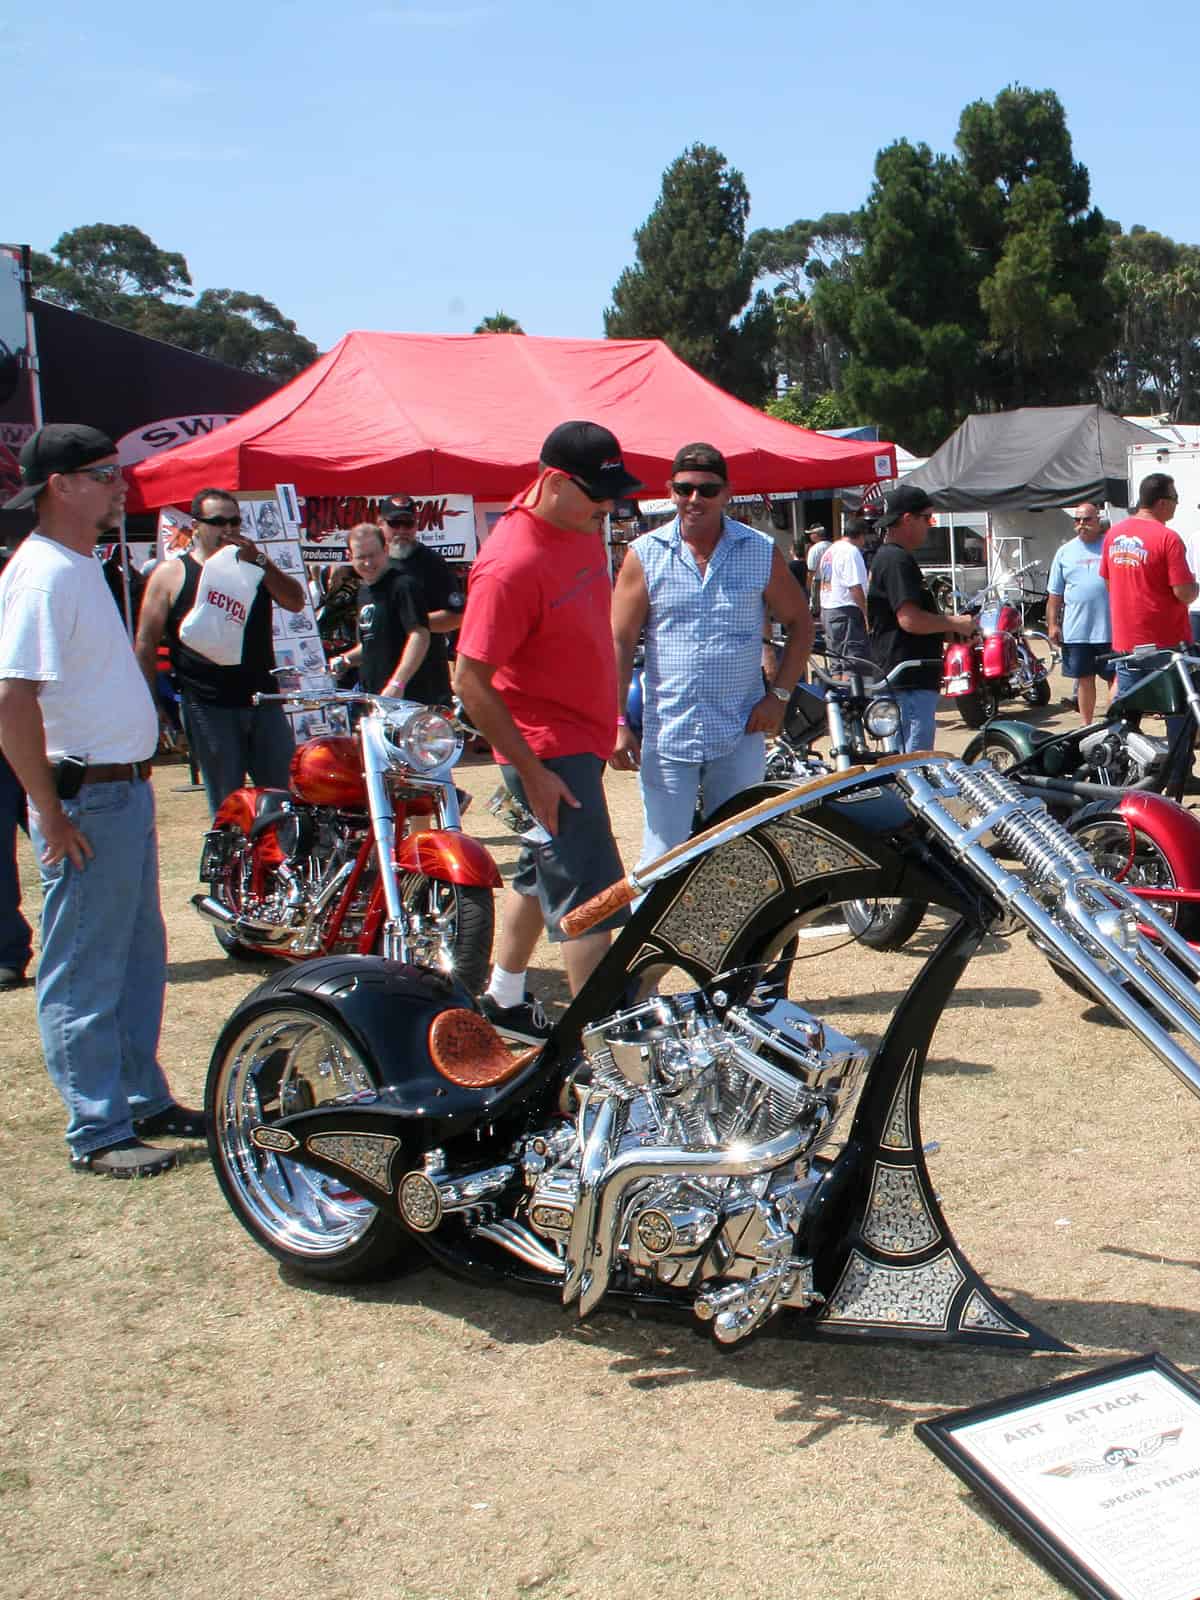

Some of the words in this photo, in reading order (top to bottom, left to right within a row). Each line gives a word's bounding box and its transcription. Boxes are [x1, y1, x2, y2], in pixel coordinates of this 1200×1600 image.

[302, 549, 343, 560] troducing
[1003, 1422, 1046, 1445] ART
[1064, 1391, 1145, 1424] ATTACK
